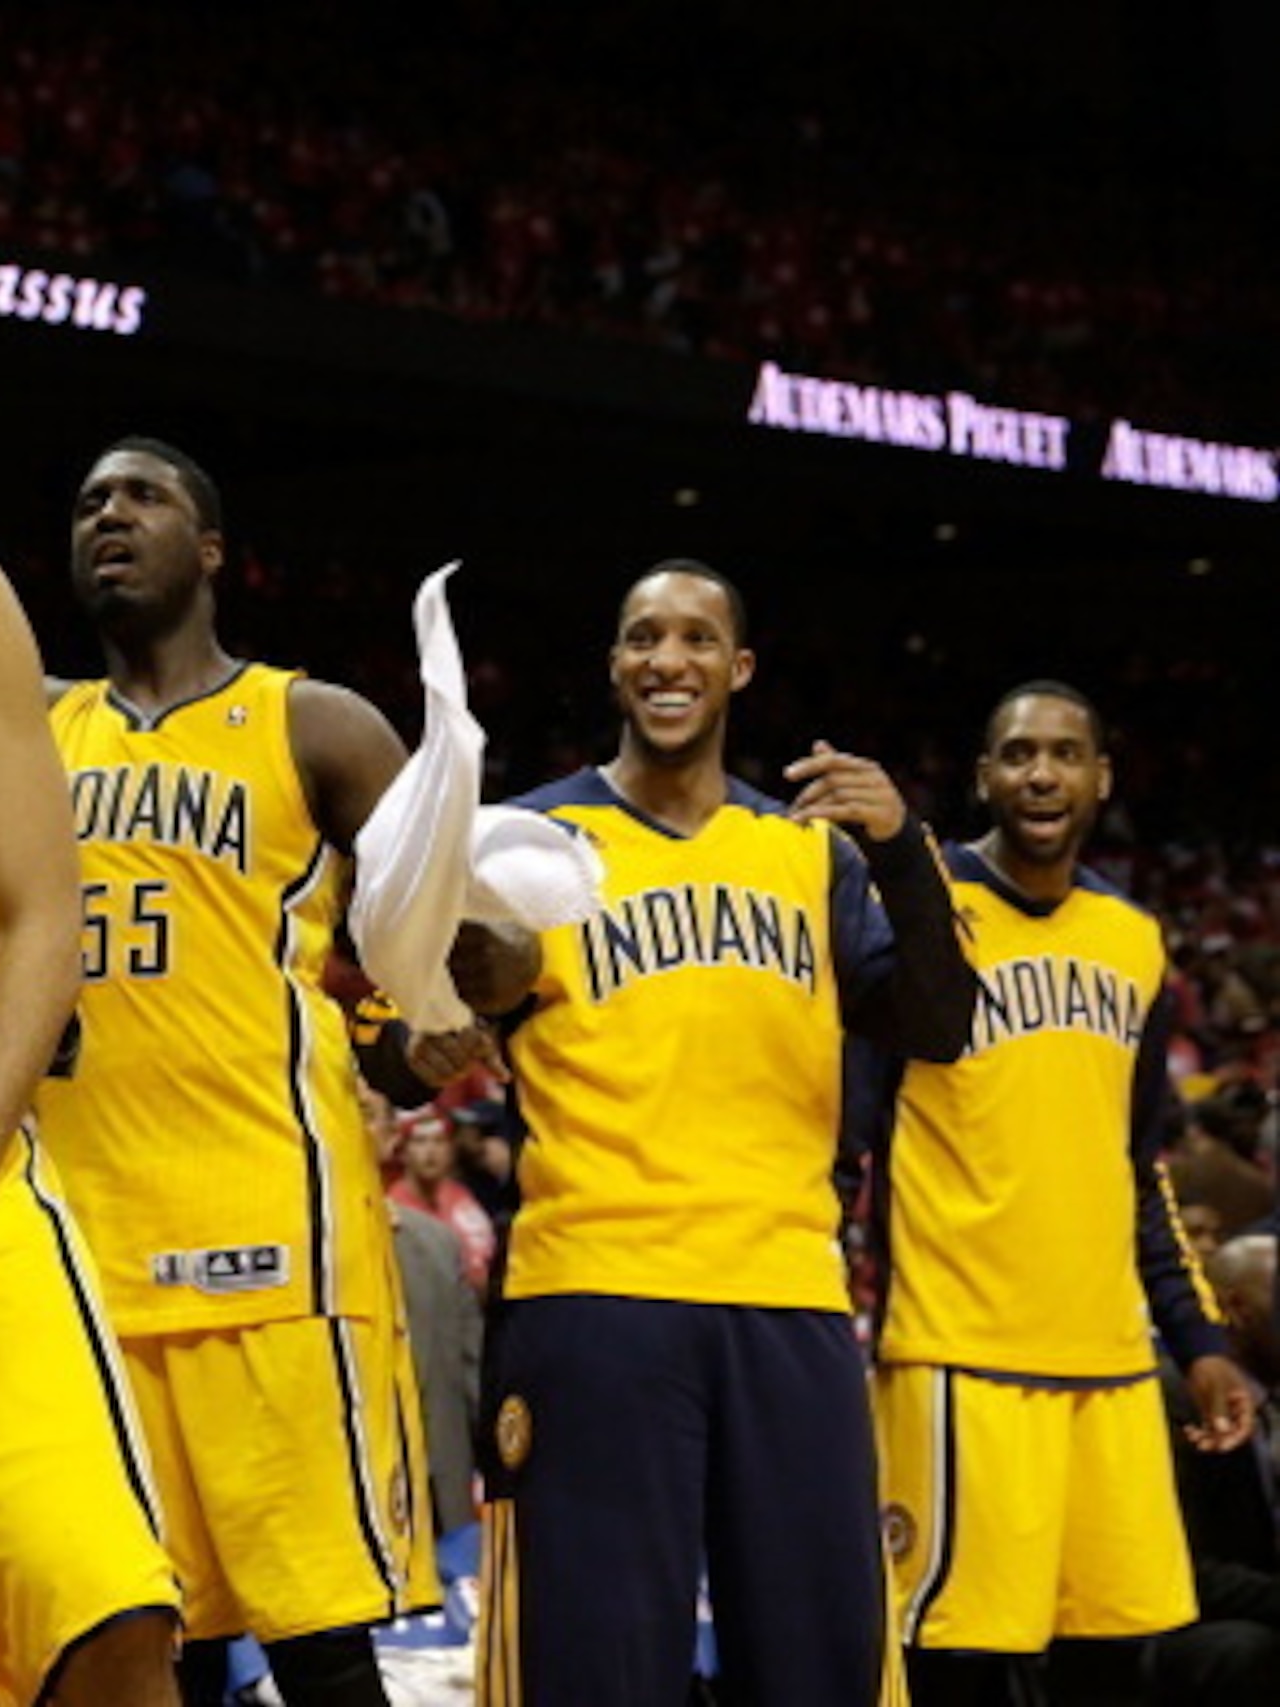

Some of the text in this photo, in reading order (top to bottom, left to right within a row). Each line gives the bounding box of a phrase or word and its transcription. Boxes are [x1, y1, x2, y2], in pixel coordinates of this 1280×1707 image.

[71, 762, 250, 876] DIANA
[80, 880, 170, 980] 55
[581, 882, 818, 1006] INDIANA
